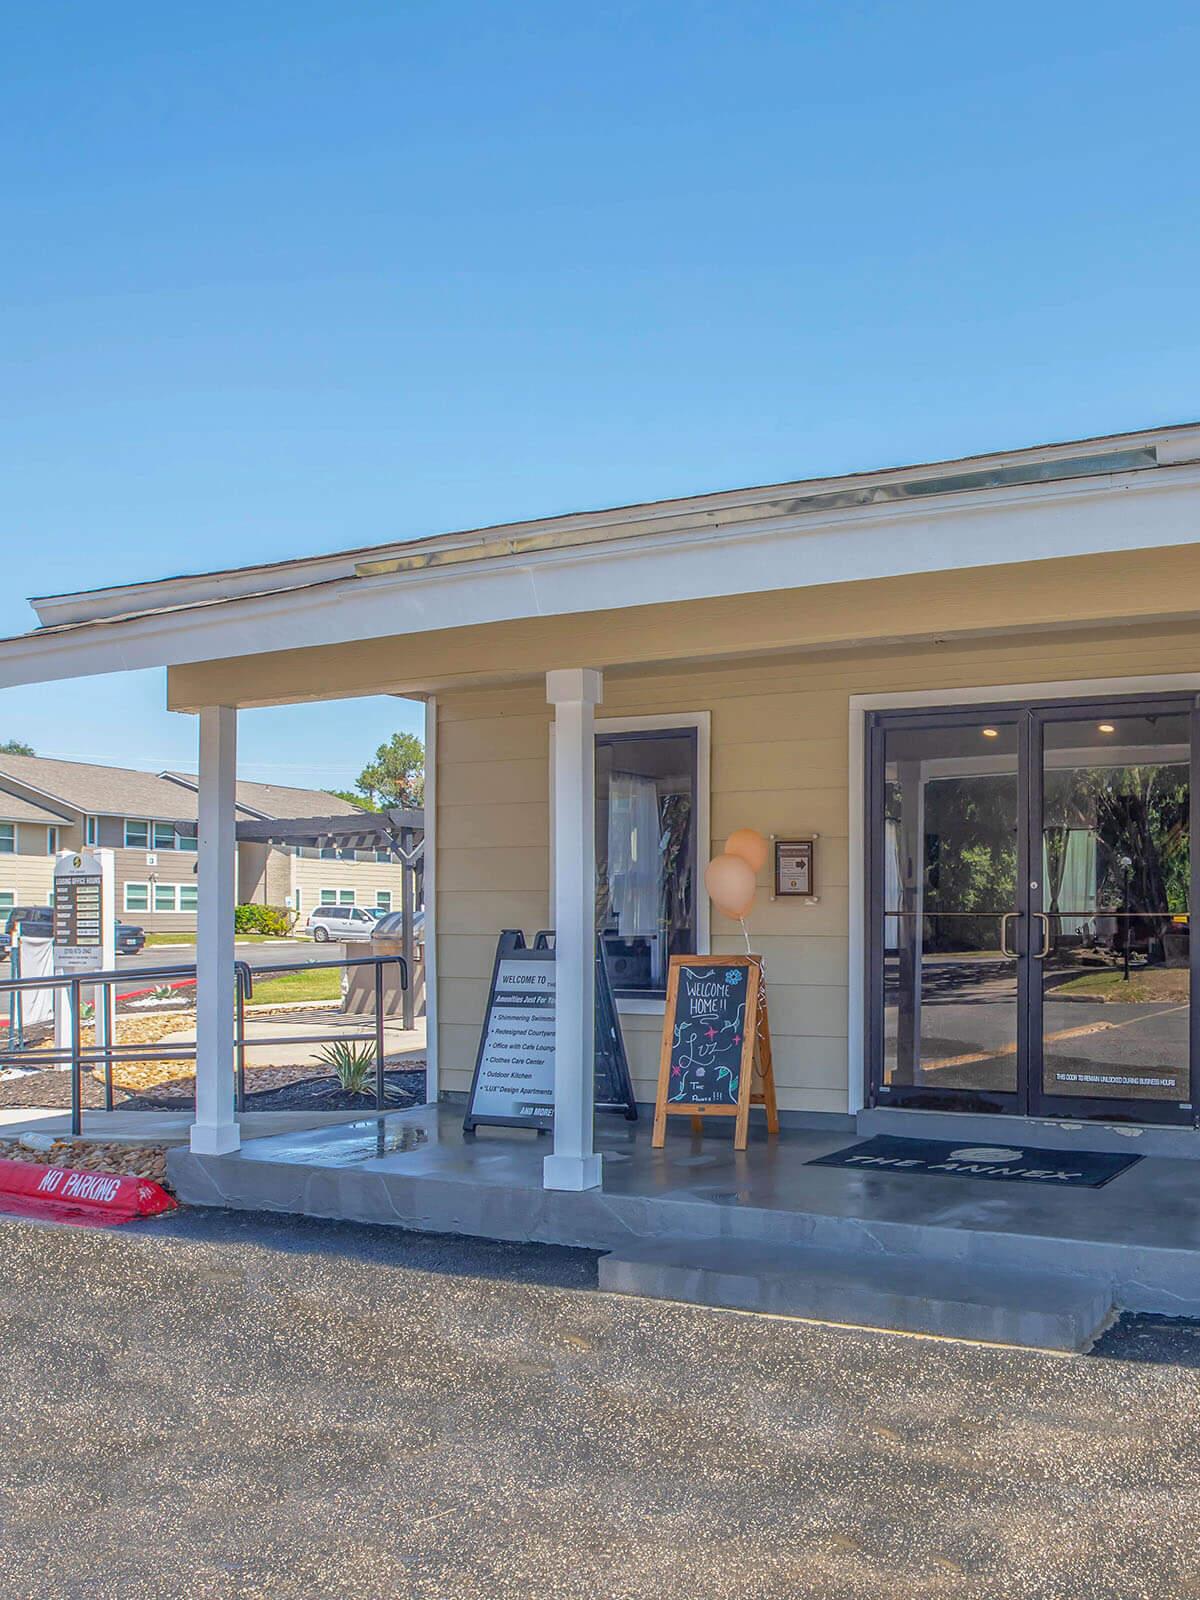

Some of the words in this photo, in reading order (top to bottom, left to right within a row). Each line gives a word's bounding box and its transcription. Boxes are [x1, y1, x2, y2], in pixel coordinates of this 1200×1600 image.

[502, 975, 536, 984] WELCOME
[537, 976, 546, 984] TO
[686, 982, 730, 997] WELCOME
[523, 996, 536, 1004] Just
[536, 996, 547, 1004] For
[690, 998, 727, 1015] HOME!!
[498, 1014, 530, 1022] Shimmering
[499, 1086, 520, 1094] Design
[520, 1087, 553, 1096] Apartments
[520, 1107, 533, 1116] AND
[845, 1155, 926, 1167] THE
[928, 1163, 1083, 1180] ANNEX
[38, 1169, 65, 1192] NO
[61, 1174, 121, 1202] PARKING
